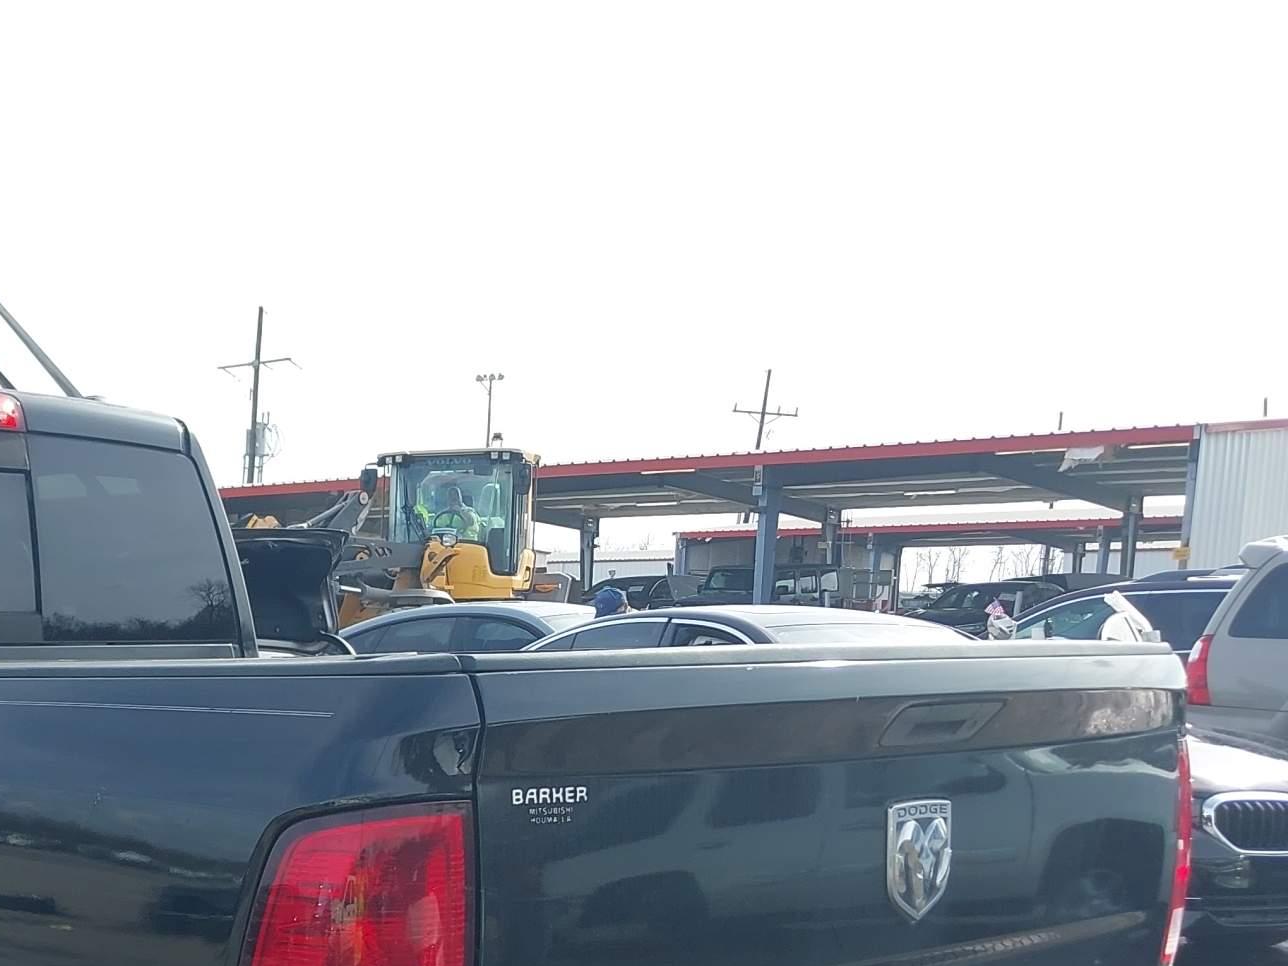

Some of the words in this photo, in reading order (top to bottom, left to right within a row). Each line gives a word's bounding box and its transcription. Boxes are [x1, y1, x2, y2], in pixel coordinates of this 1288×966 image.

[512, 786, 588, 805] BARKER
[528, 807, 574, 816] MITSUBISHI
[897, 803, 948, 818] DODGE
